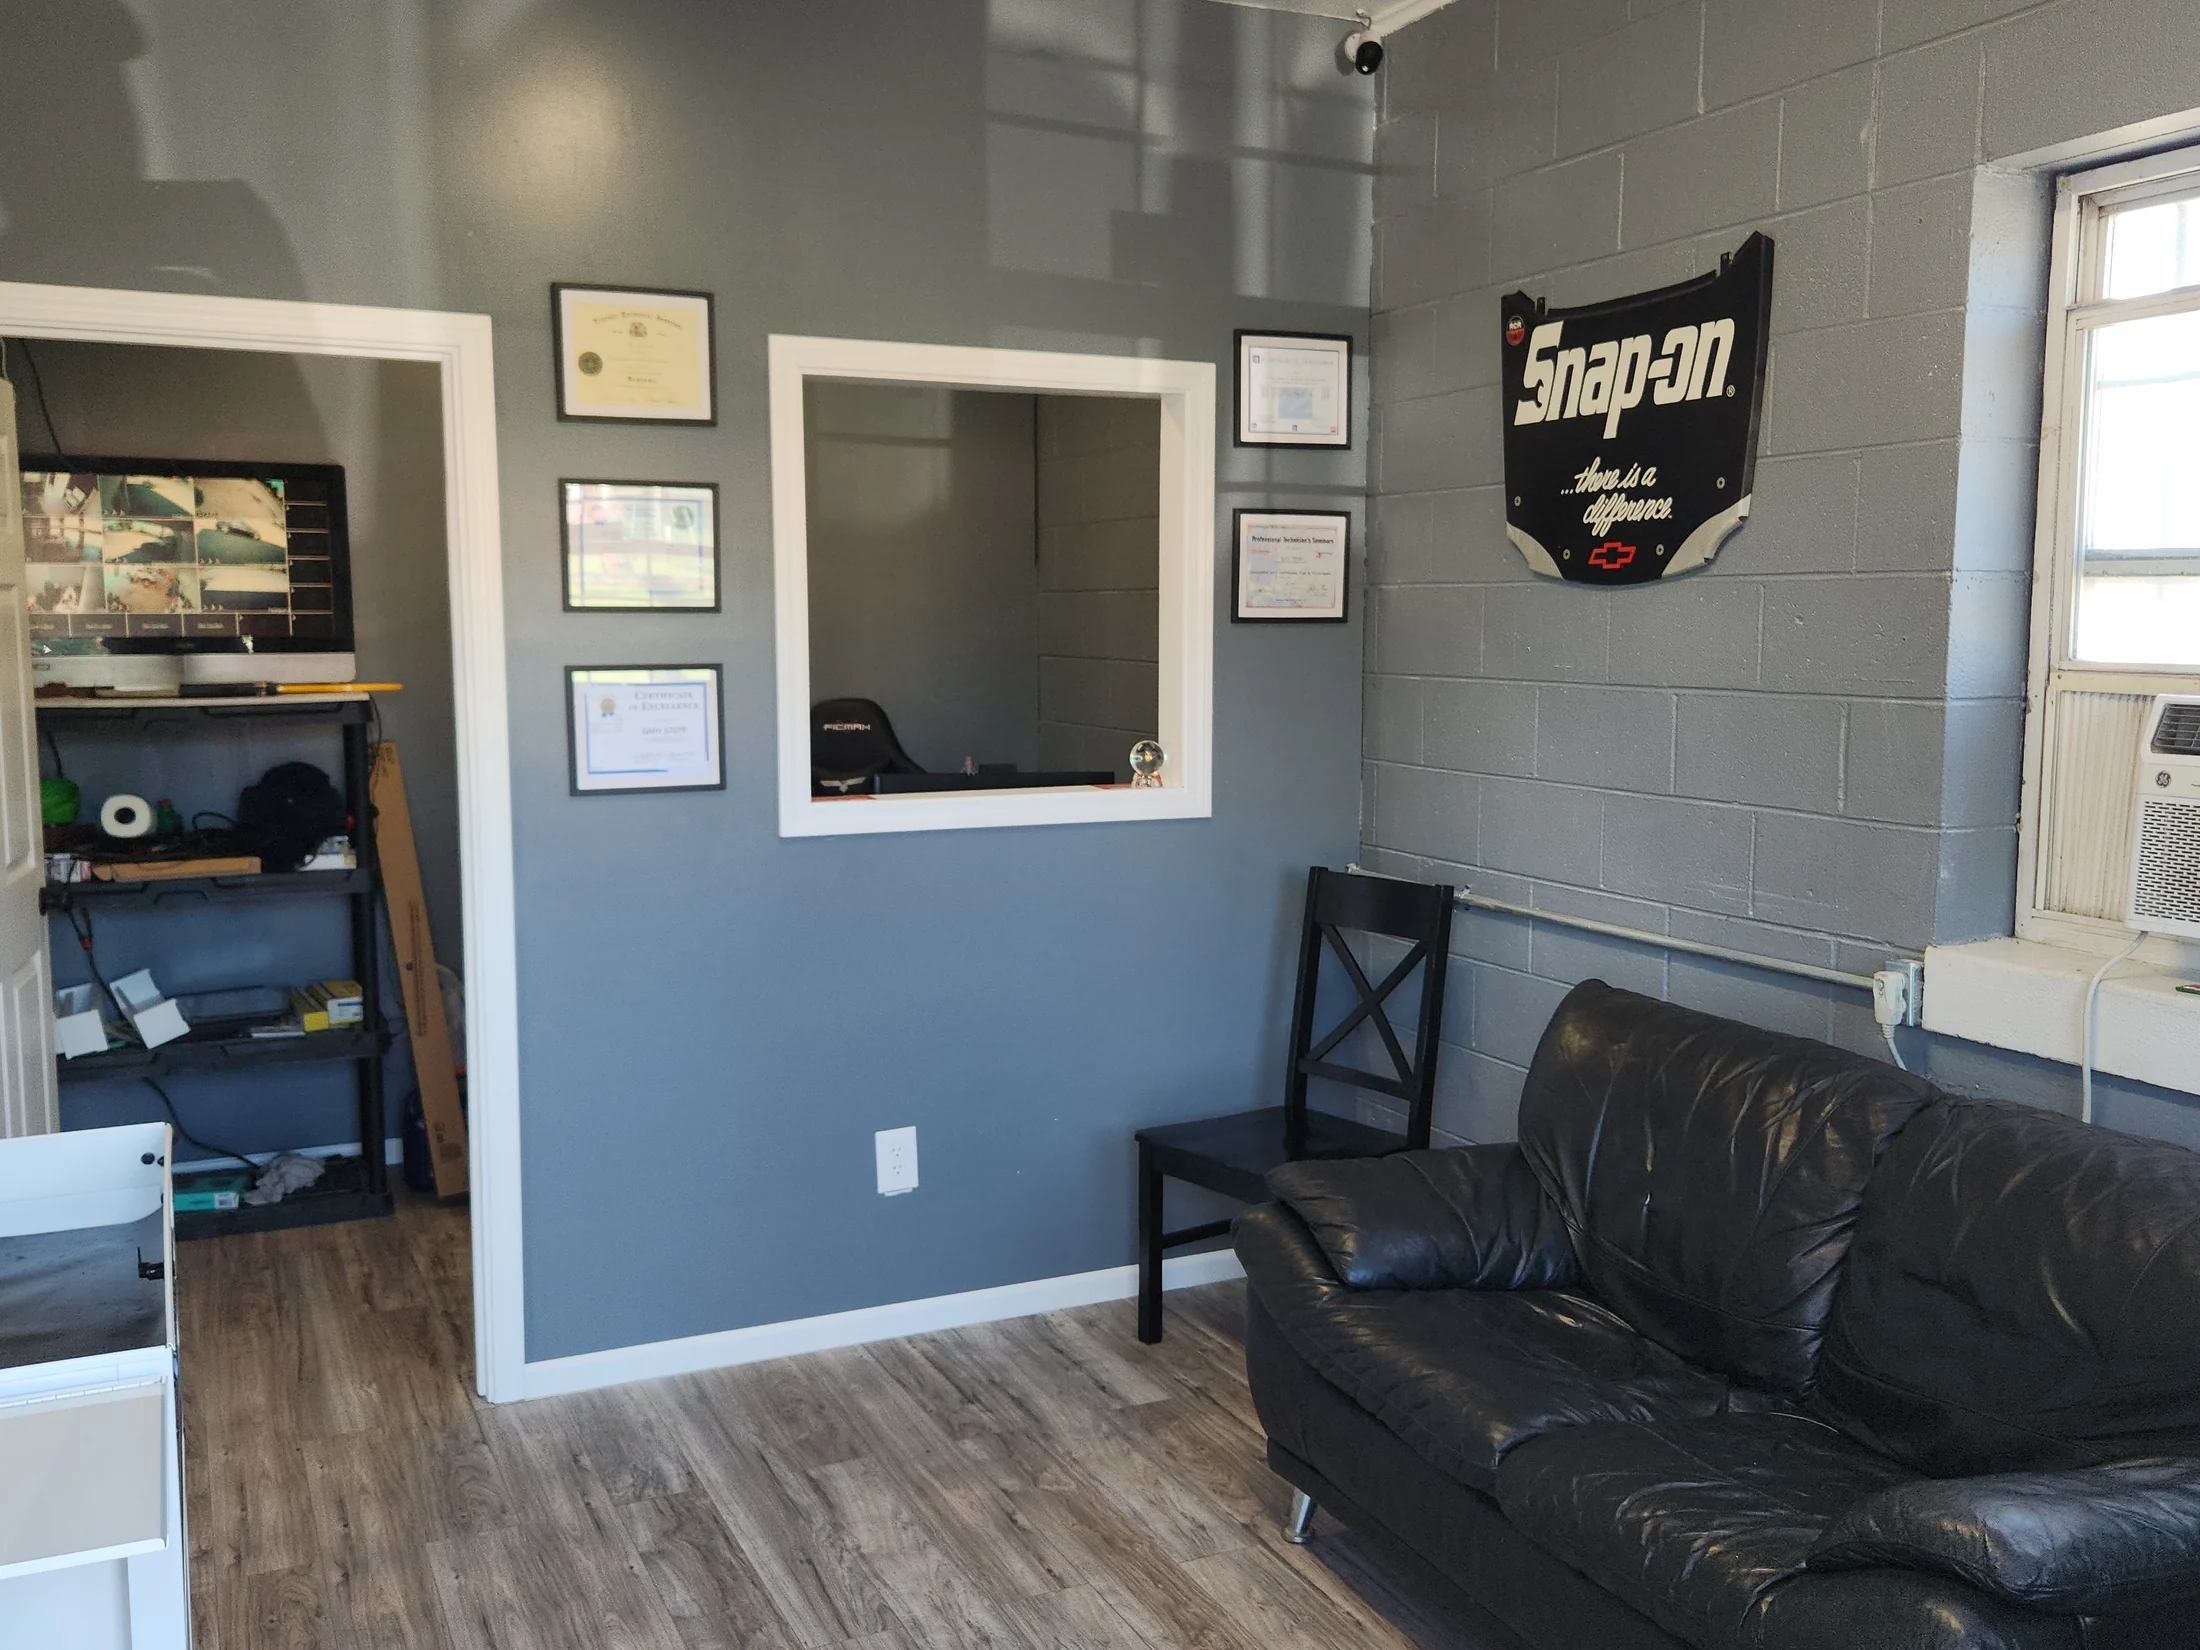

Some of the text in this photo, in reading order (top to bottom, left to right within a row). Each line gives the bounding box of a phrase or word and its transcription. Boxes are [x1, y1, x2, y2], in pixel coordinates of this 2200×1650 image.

[1514, 318, 1735, 440] Snap-on
[1617, 462, 1642, 489] is
[1640, 466, 1657, 487] a
[1251, 535, 1281, 543] Professional
[1312, 537, 1334, 545] Seminars
